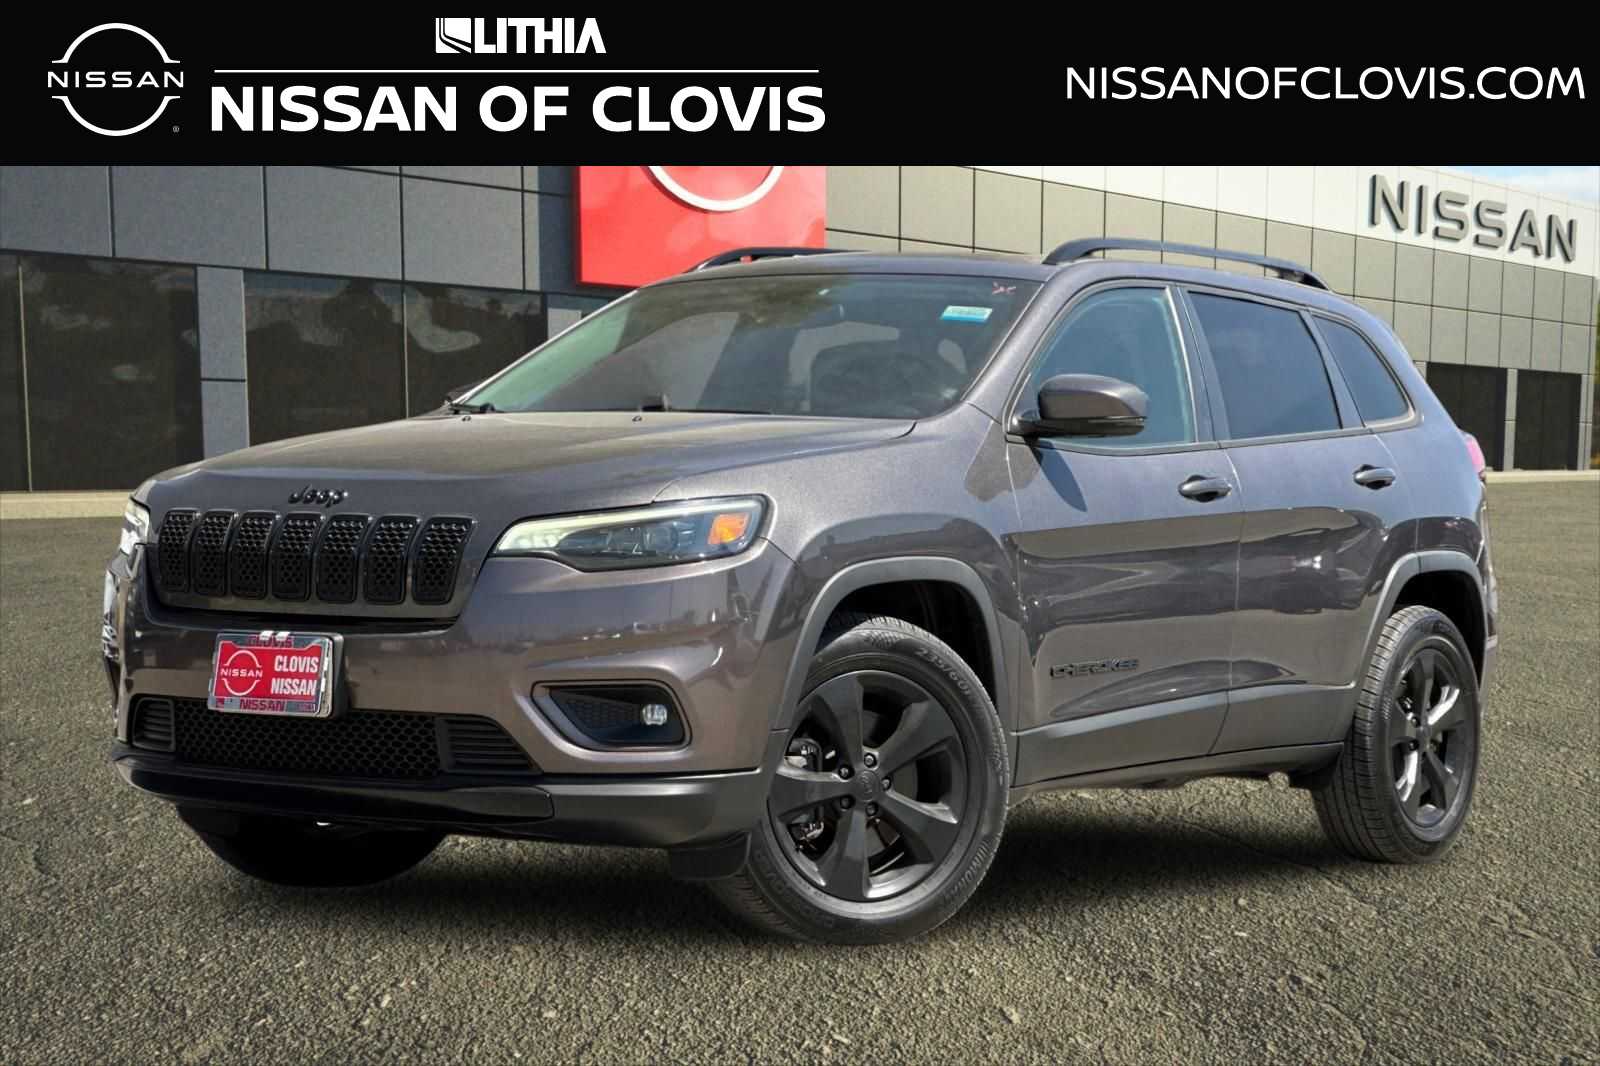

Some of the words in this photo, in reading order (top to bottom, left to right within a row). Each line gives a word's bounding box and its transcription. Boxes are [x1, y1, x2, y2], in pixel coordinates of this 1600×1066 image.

[1369, 173, 1578, 262] NISSAN
[220, 668, 263, 677] NISSAN
[274, 655, 319, 673] CLOVIS
[270, 678, 317, 695] NISSAN
[240, 698, 285, 712] NISSAN
